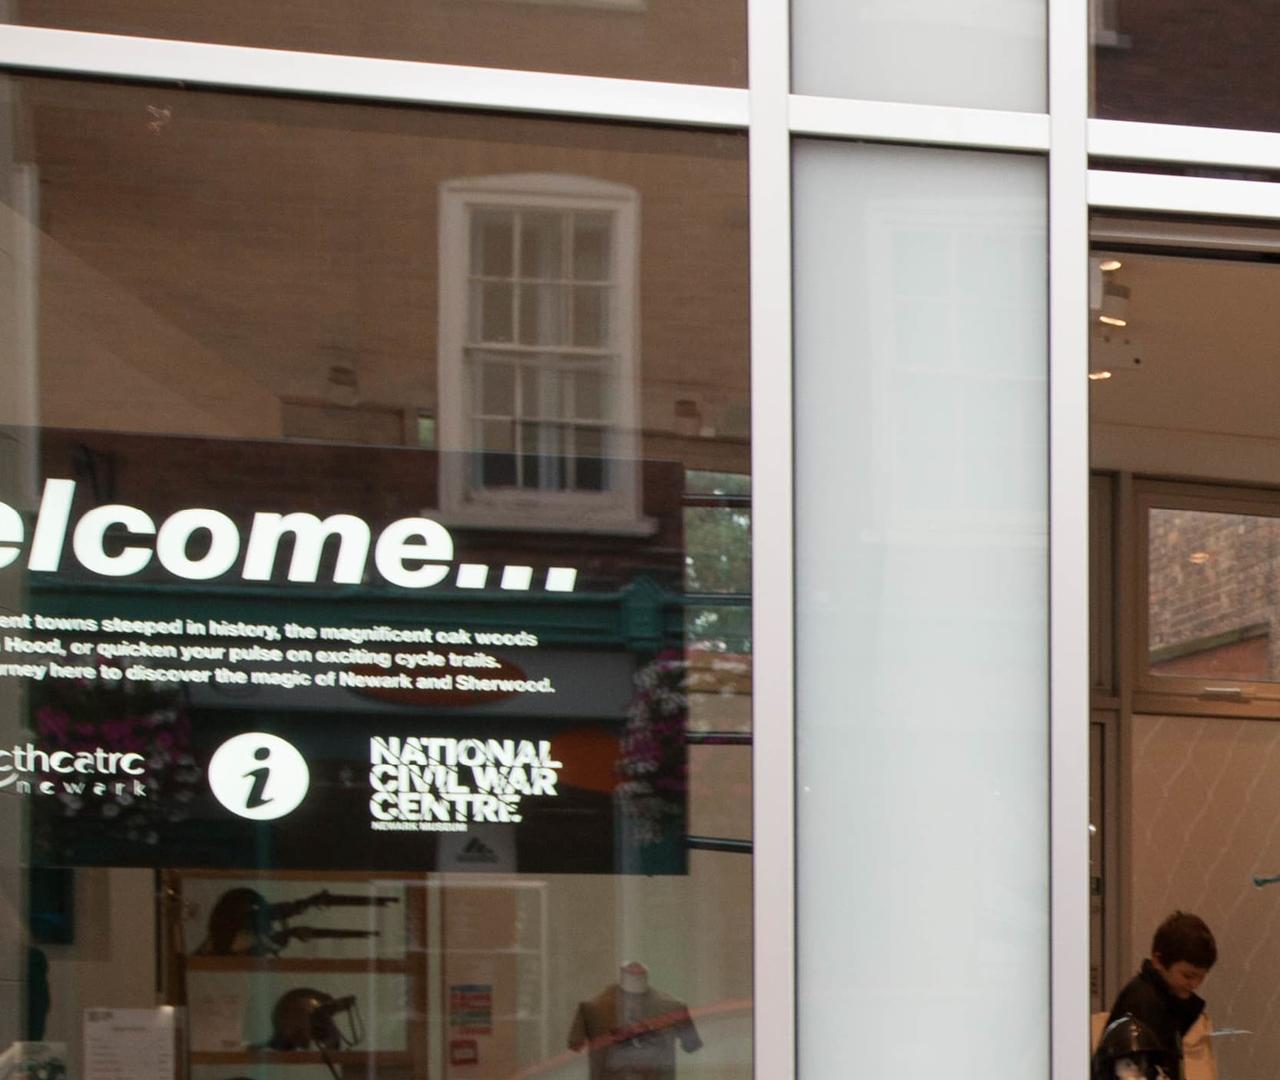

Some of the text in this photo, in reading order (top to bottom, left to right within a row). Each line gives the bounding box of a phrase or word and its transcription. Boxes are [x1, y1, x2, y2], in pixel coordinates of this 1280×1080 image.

[34, 614, 98, 632] towns
[101, 617, 183, 636] steeped
[186, 619, 206, 635] in
[208, 620, 281, 641] history,
[284, 622, 317, 640] the
[320, 626, 433, 644] magnificent
[435, 629, 472, 645] oak
[474, 631, 538, 647] woods
[4, 636, 502, 668] Hood, or quicken your pulse on exciting cycle trails.
[50, 662, 96, 679] here
[100, 664, 123, 680] to
[125, 664, 212, 682] discover
[215, 667, 248, 684] the
[250, 668, 312, 688] magic
[314, 671, 336, 687] of
[339, 671, 413, 689] Newark
[415, 674, 453, 690] and
[455, 676, 555, 693] Sherwood.
[369, 735, 564, 769] NATIONAL
[369, 764, 559, 796] CIVIL WAR
[369, 791, 523, 823] CENTRE
